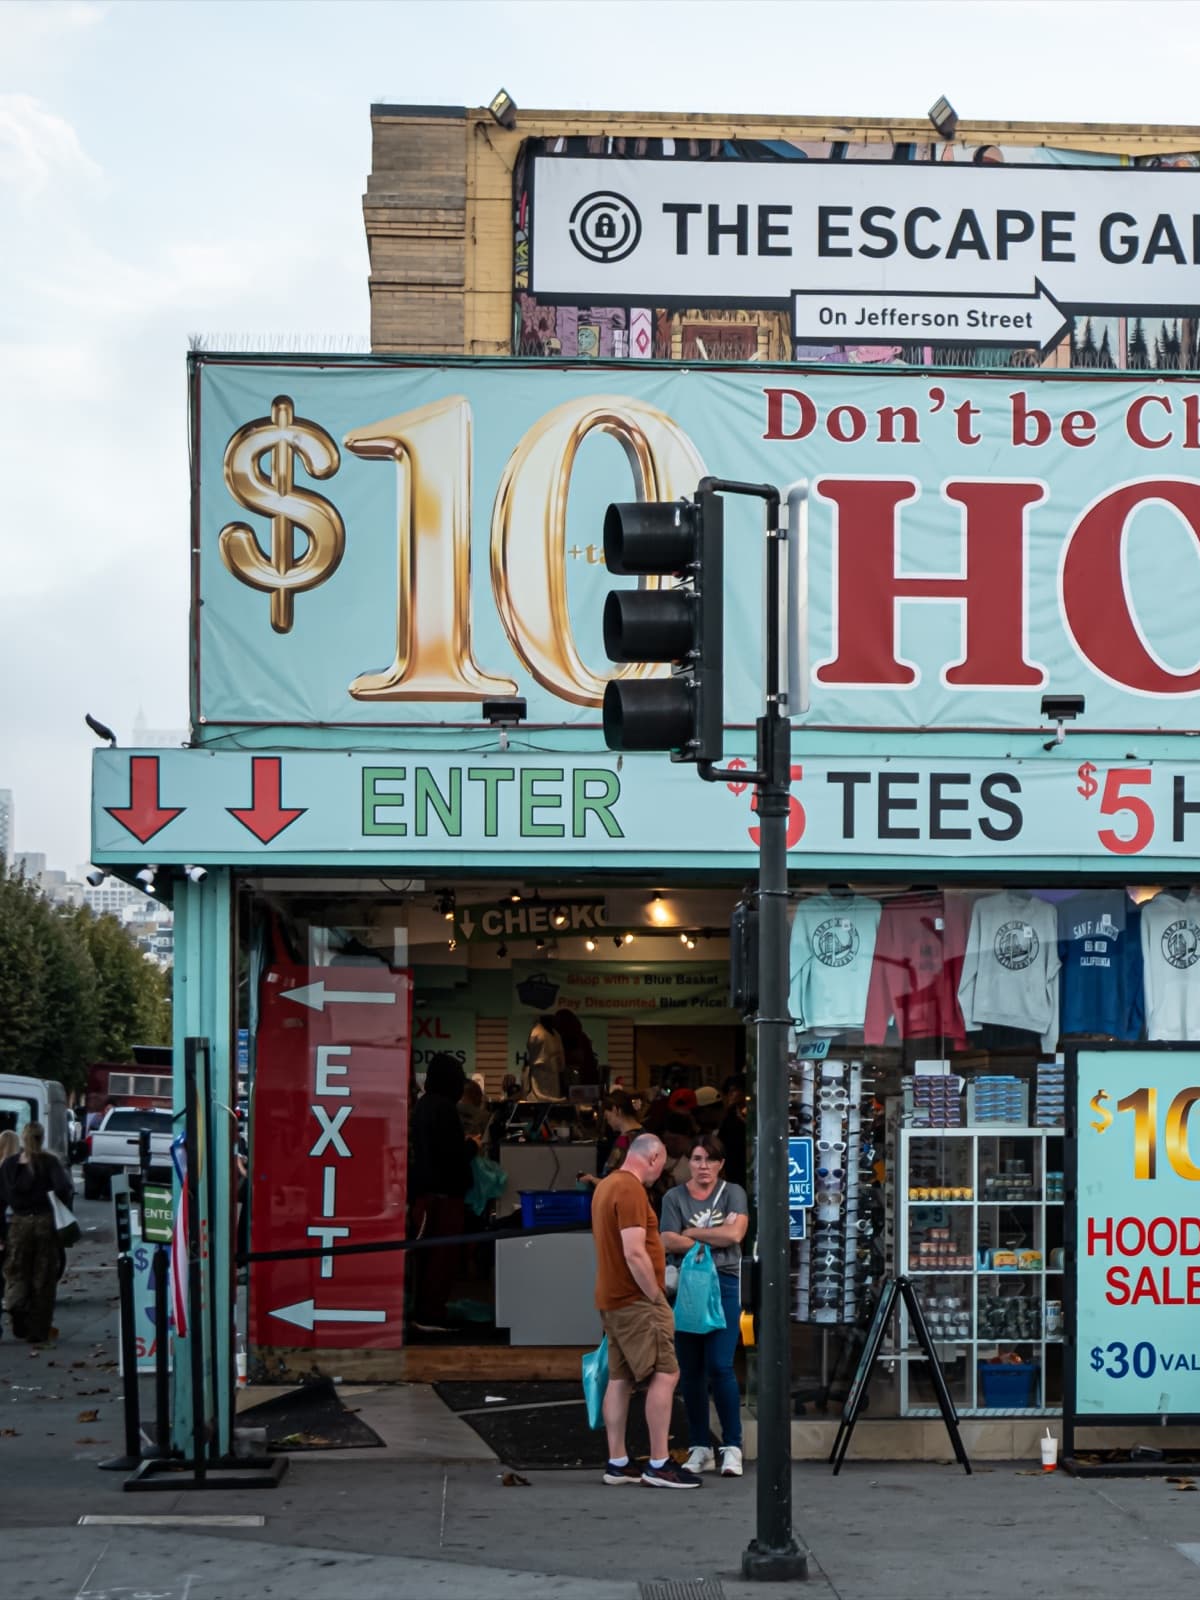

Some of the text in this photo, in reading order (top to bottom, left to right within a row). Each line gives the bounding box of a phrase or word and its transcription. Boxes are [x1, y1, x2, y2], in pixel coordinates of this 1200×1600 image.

[662, 203, 793, 256] THE
[817, 206, 1076, 262] ESCAPE
[818, 306, 1033, 329] On Jefferson Street
[762, 387, 982, 446] Don't
[1010, 391, 1098, 448] be
[361, 766, 625, 839] ENTER
[826, 771, 1024, 841] TEES
[1076, 761, 1155, 855] $5
[306, 1045, 353, 1278] EXIT
[1090, 1342, 1157, 1380] $30
